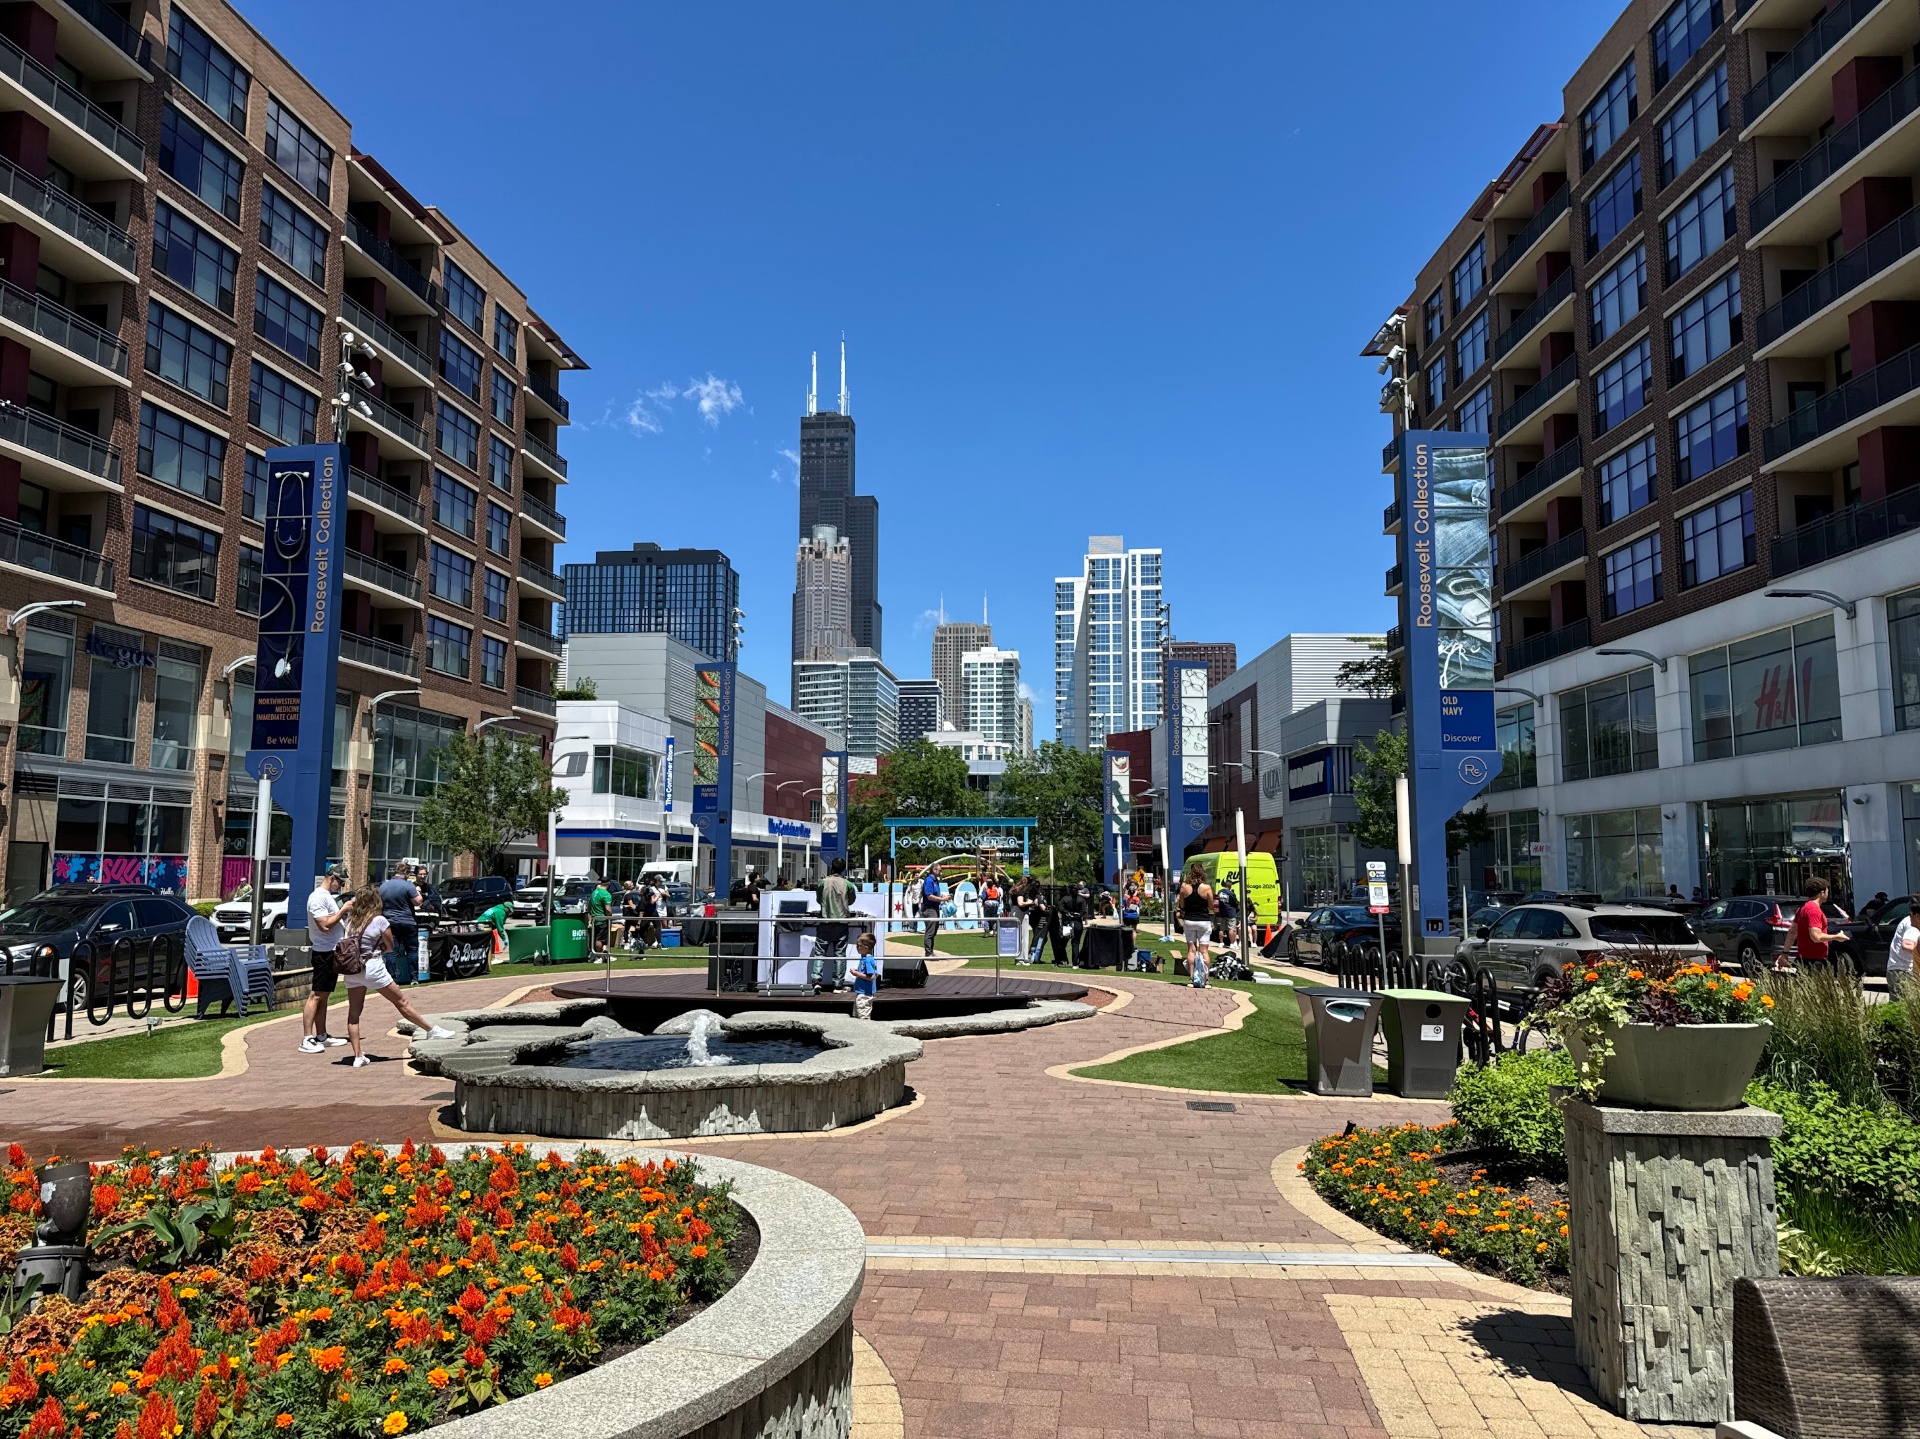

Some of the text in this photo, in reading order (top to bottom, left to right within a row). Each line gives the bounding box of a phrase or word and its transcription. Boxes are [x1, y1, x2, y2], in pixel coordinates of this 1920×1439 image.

[311, 456, 334, 633] Roosevelt Collection
[1412, 444, 1432, 627] Roosevelt Collection
[86, 633, 157, 669] Regus
[1442, 696, 1458, 705] OLD
[1754, 656, 1813, 729] H&M
[256, 713, 300, 721] IMMEDIATE CARE
[722, 668, 731, 756] Roosevelt Collection
[1172, 666, 1180, 756] Roosevelt Collection
[1442, 706, 1463, 716] NAVY
[266, 736, 277, 744] Be
[1443, 733, 1482, 742] Discover
